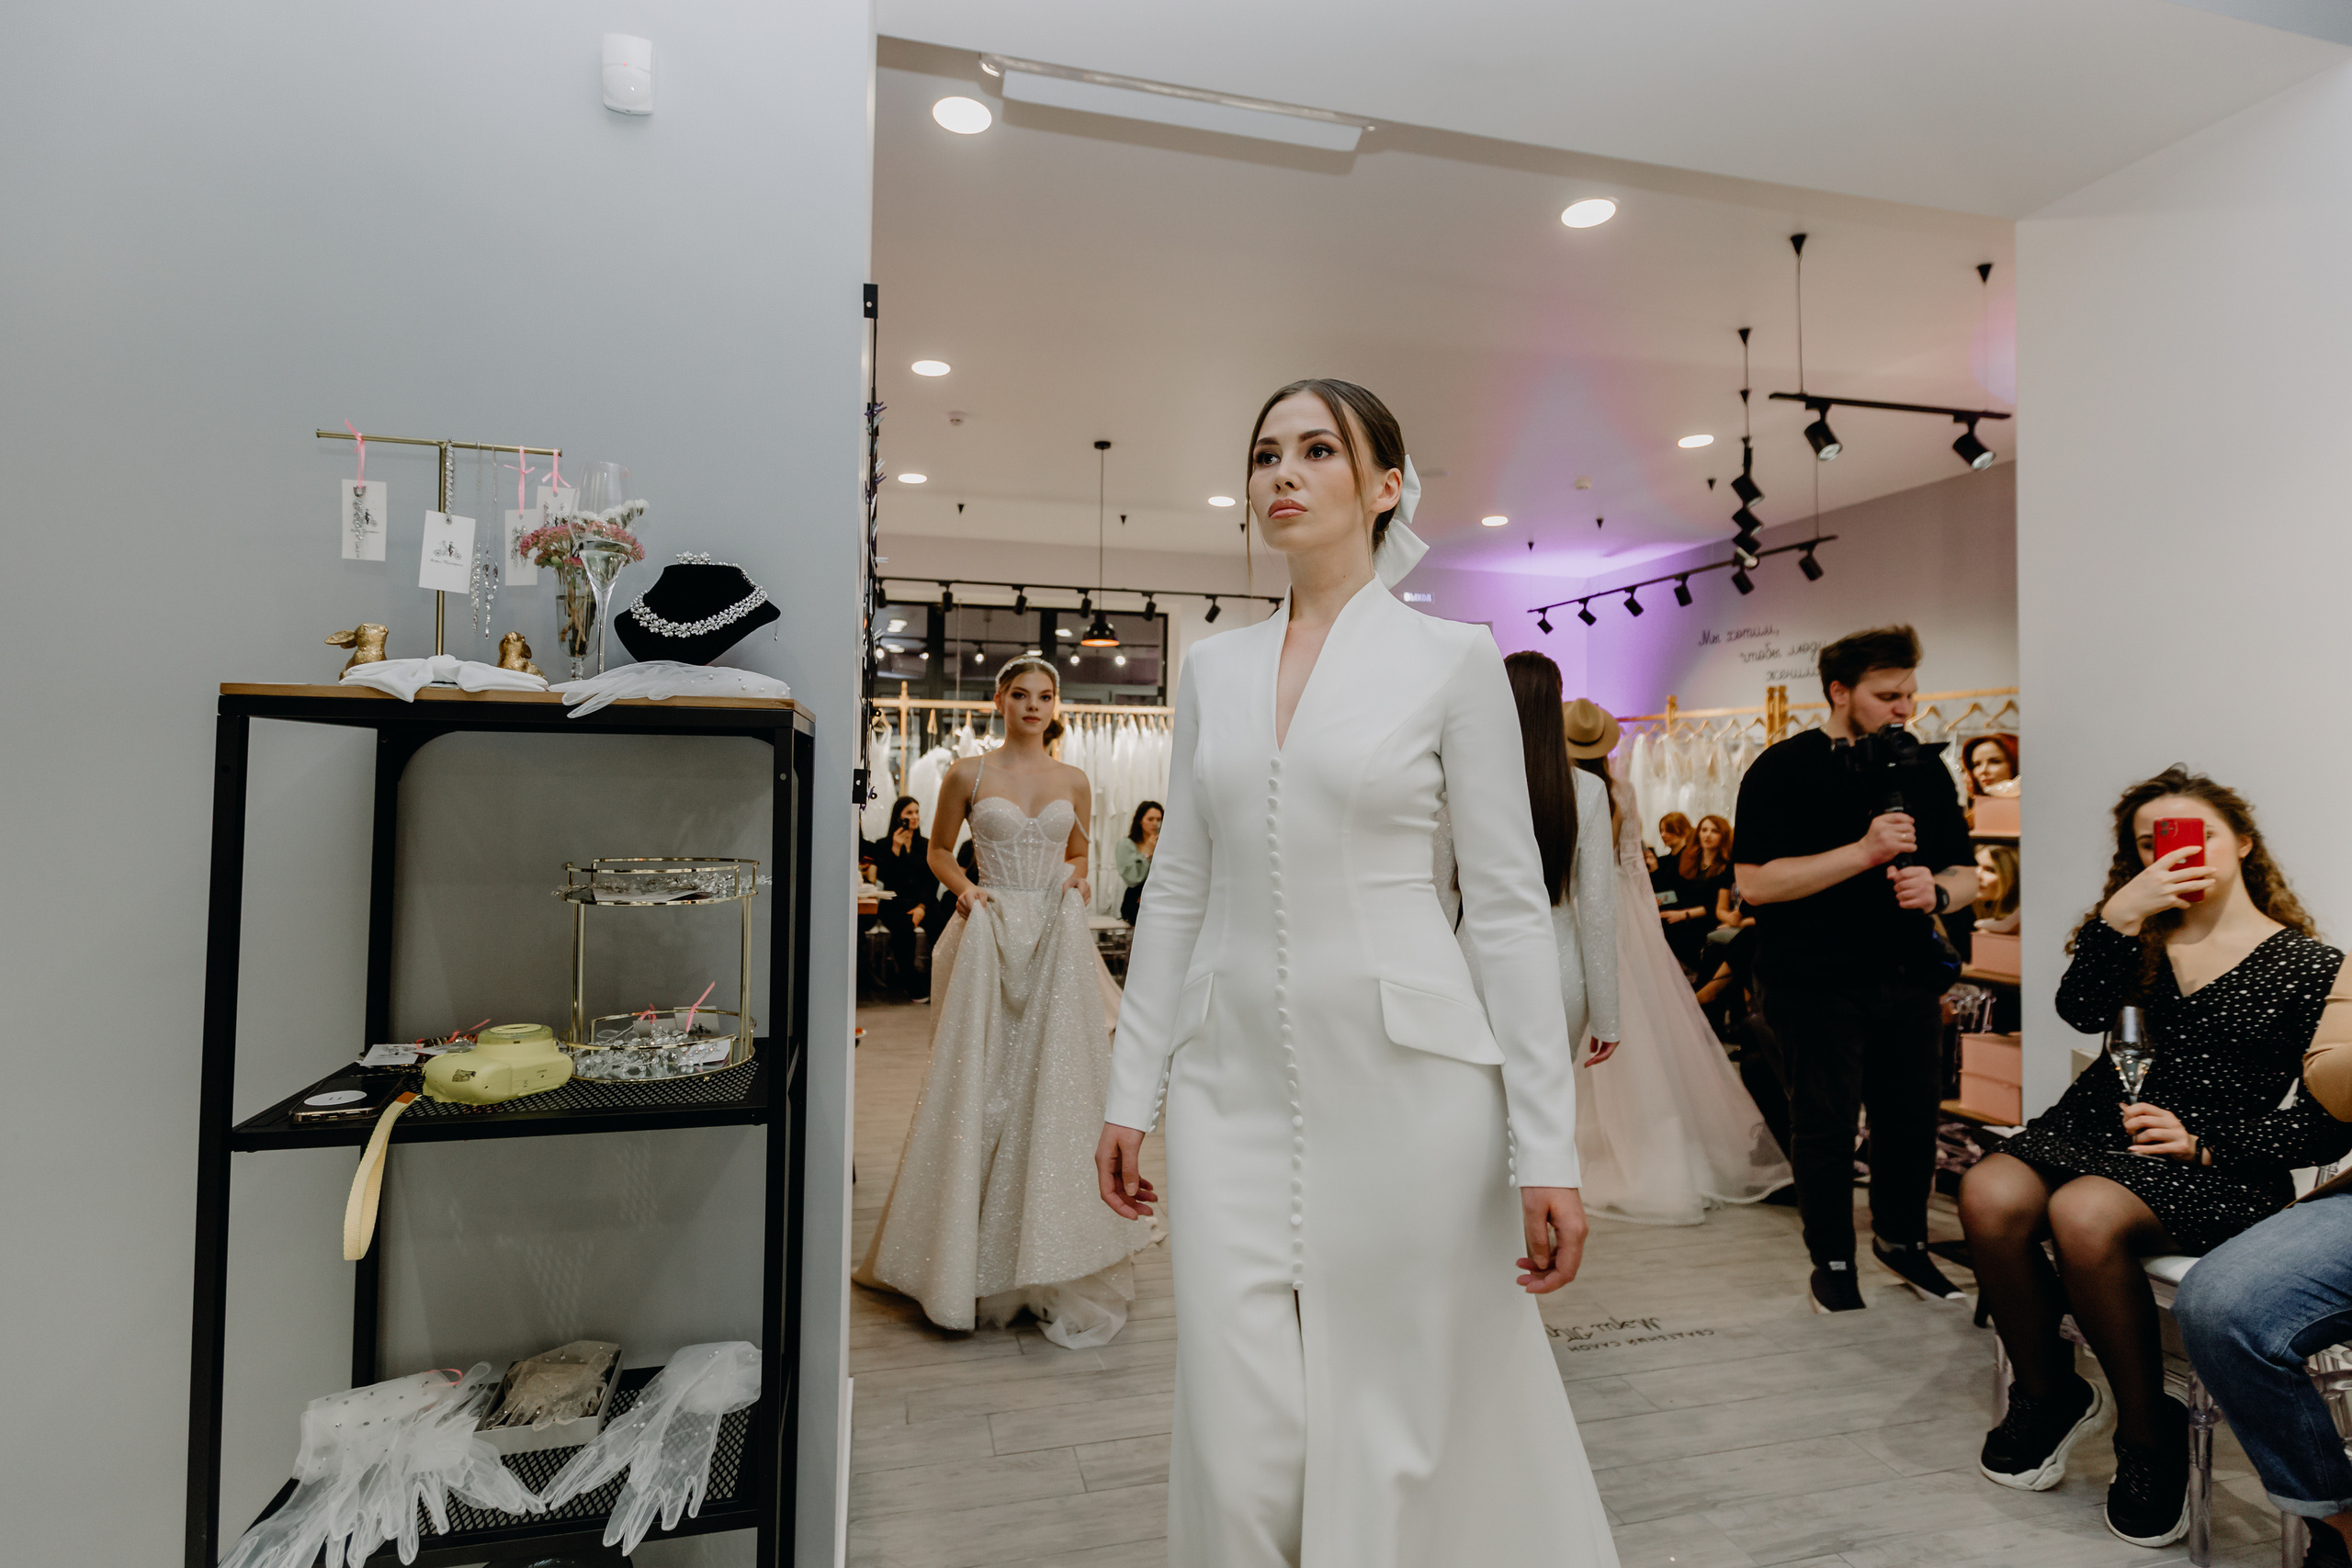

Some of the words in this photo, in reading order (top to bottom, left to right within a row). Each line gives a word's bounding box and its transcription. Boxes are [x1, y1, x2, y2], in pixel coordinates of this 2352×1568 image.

[1697, 628, 1722, 647] Мы
[1726, 625, 1780, 642] хотим,
[1740, 642, 1782, 662] чтобы
[1568, 1340, 1622, 1352] САЛОН
[1626, 1328, 1714, 1346] СВАДЕБНЫЙ
